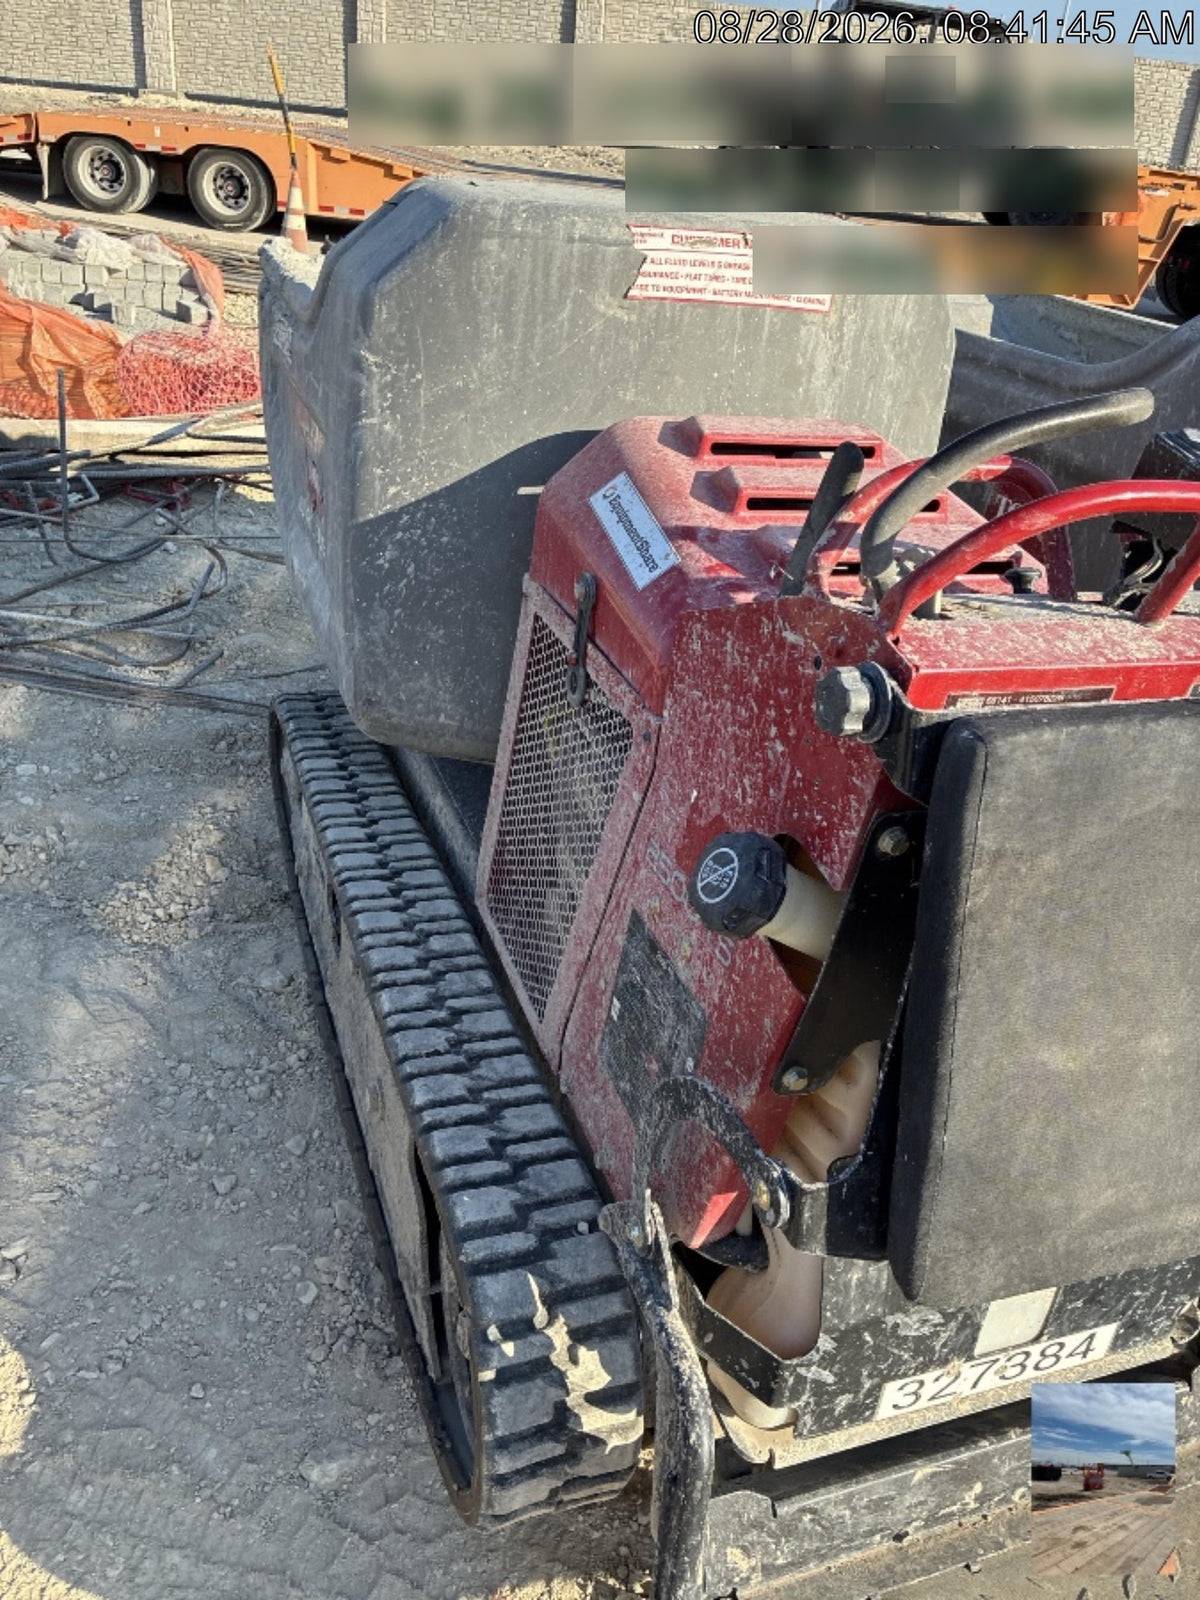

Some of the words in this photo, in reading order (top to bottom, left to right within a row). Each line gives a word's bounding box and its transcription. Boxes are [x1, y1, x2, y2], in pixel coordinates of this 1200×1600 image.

[650, 257, 663, 266] ALL
[608, 494, 659, 573] EquipmentShare
[891, 1331, 1097, 1411] 327384
